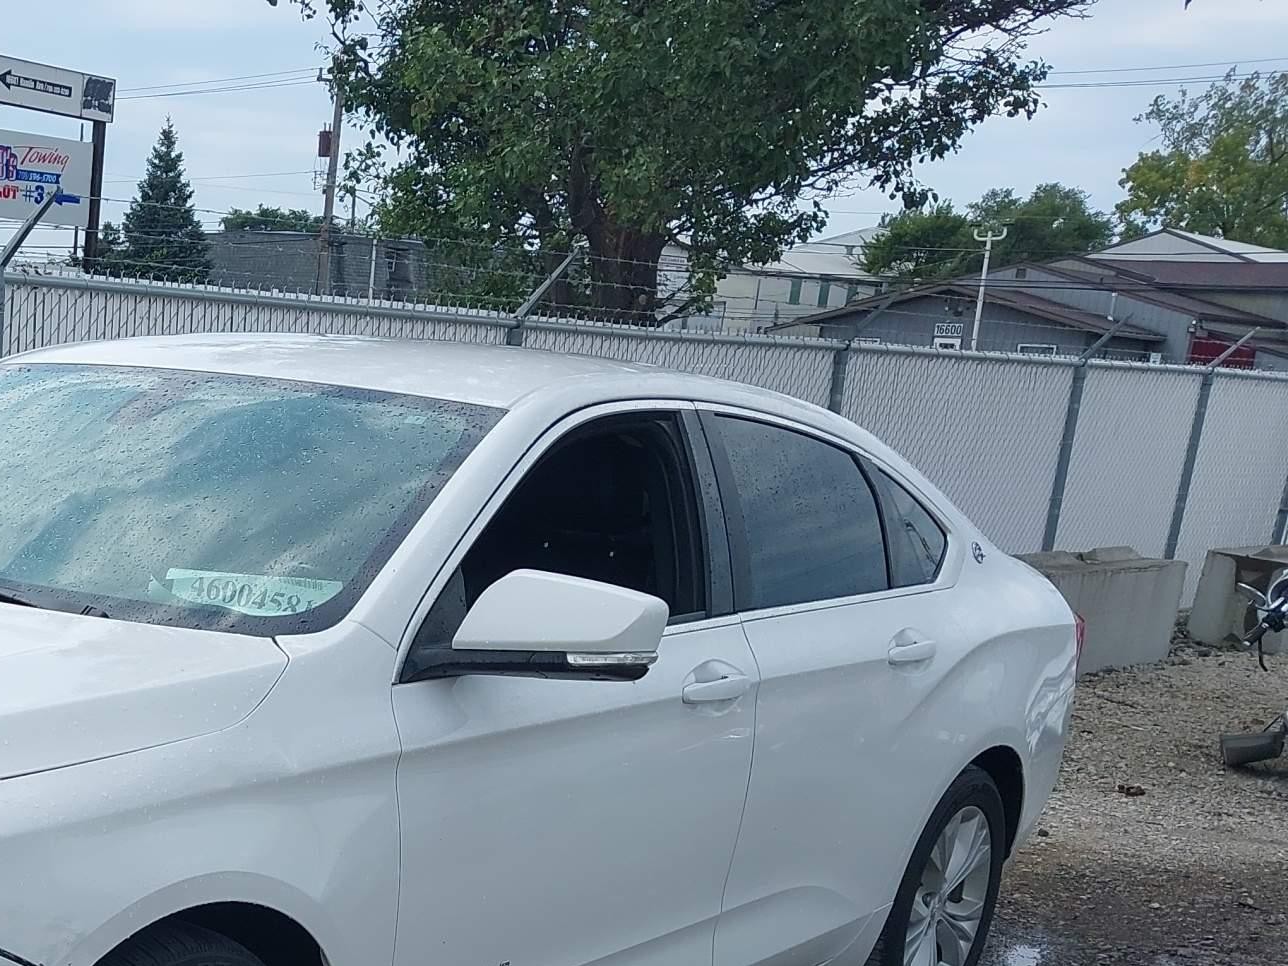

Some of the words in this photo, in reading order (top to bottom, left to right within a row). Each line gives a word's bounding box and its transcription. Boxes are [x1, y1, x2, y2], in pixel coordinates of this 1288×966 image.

[13, 146, 69, 172] Towing
[22, 184, 45, 204] #3
[935, 324, 962, 335] 16600
